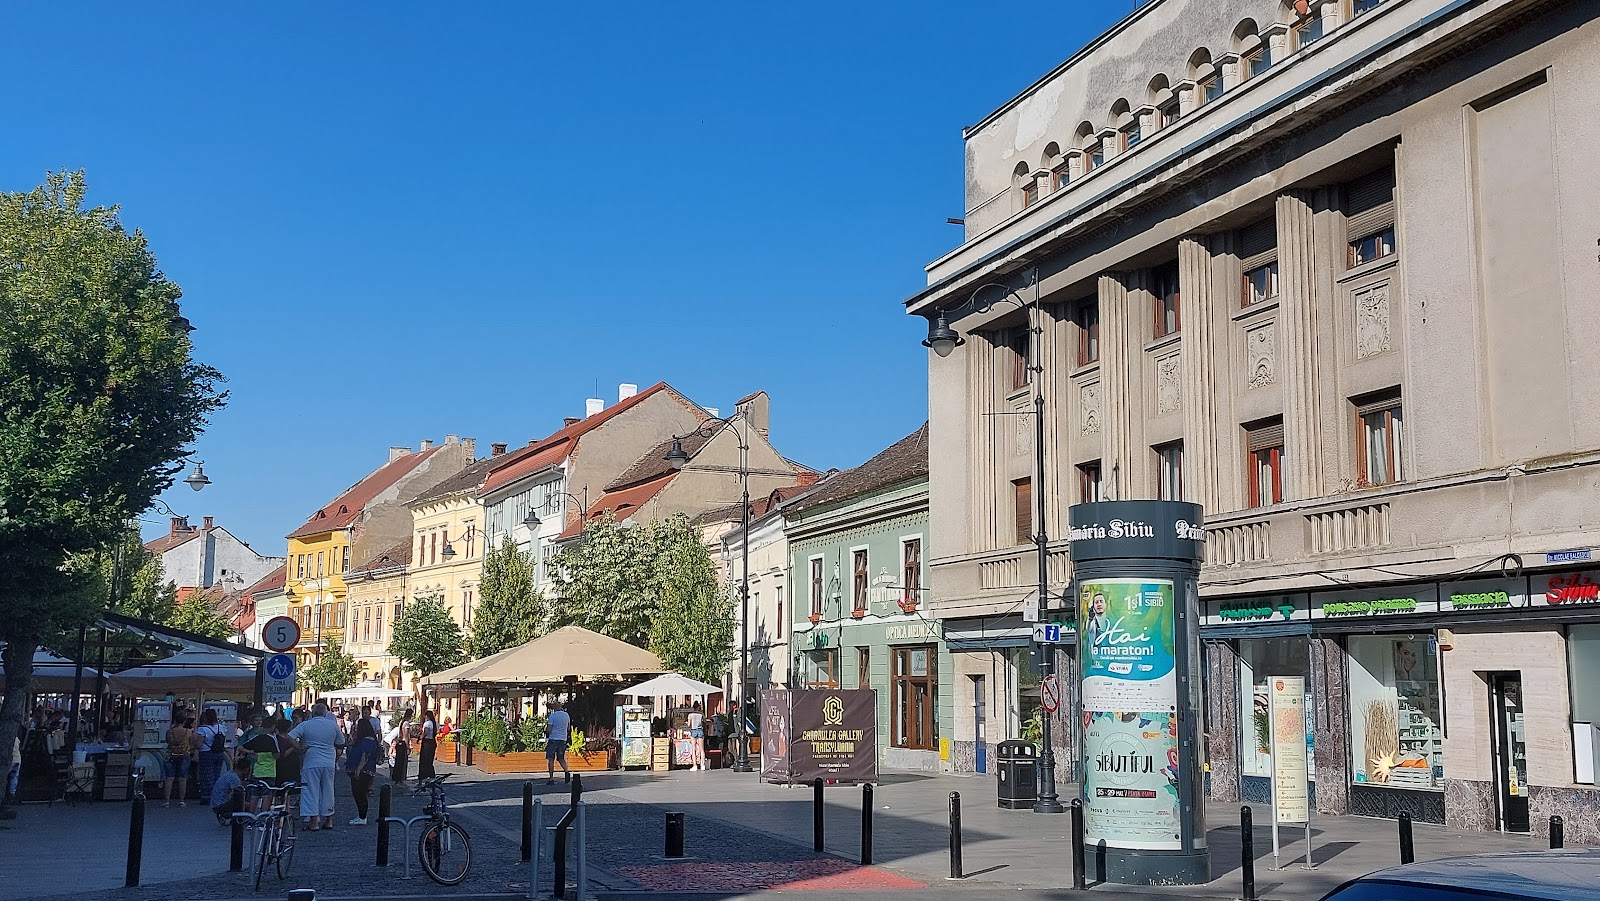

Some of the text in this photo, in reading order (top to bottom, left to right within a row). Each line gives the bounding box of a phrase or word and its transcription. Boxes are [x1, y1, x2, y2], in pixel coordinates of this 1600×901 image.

[1108, 519, 1154, 538] Sibiu
[1144, 598, 1164, 607] SIBIU
[276, 626, 287, 643] 5
[885, 625, 907, 640] OPTICA
[1095, 616, 1151, 645] Hai
[1091, 643, 1154, 656] la maraton!
[838, 729, 864, 742] GALLERY
[811, 741, 855, 754] TRANSYLVANIA
